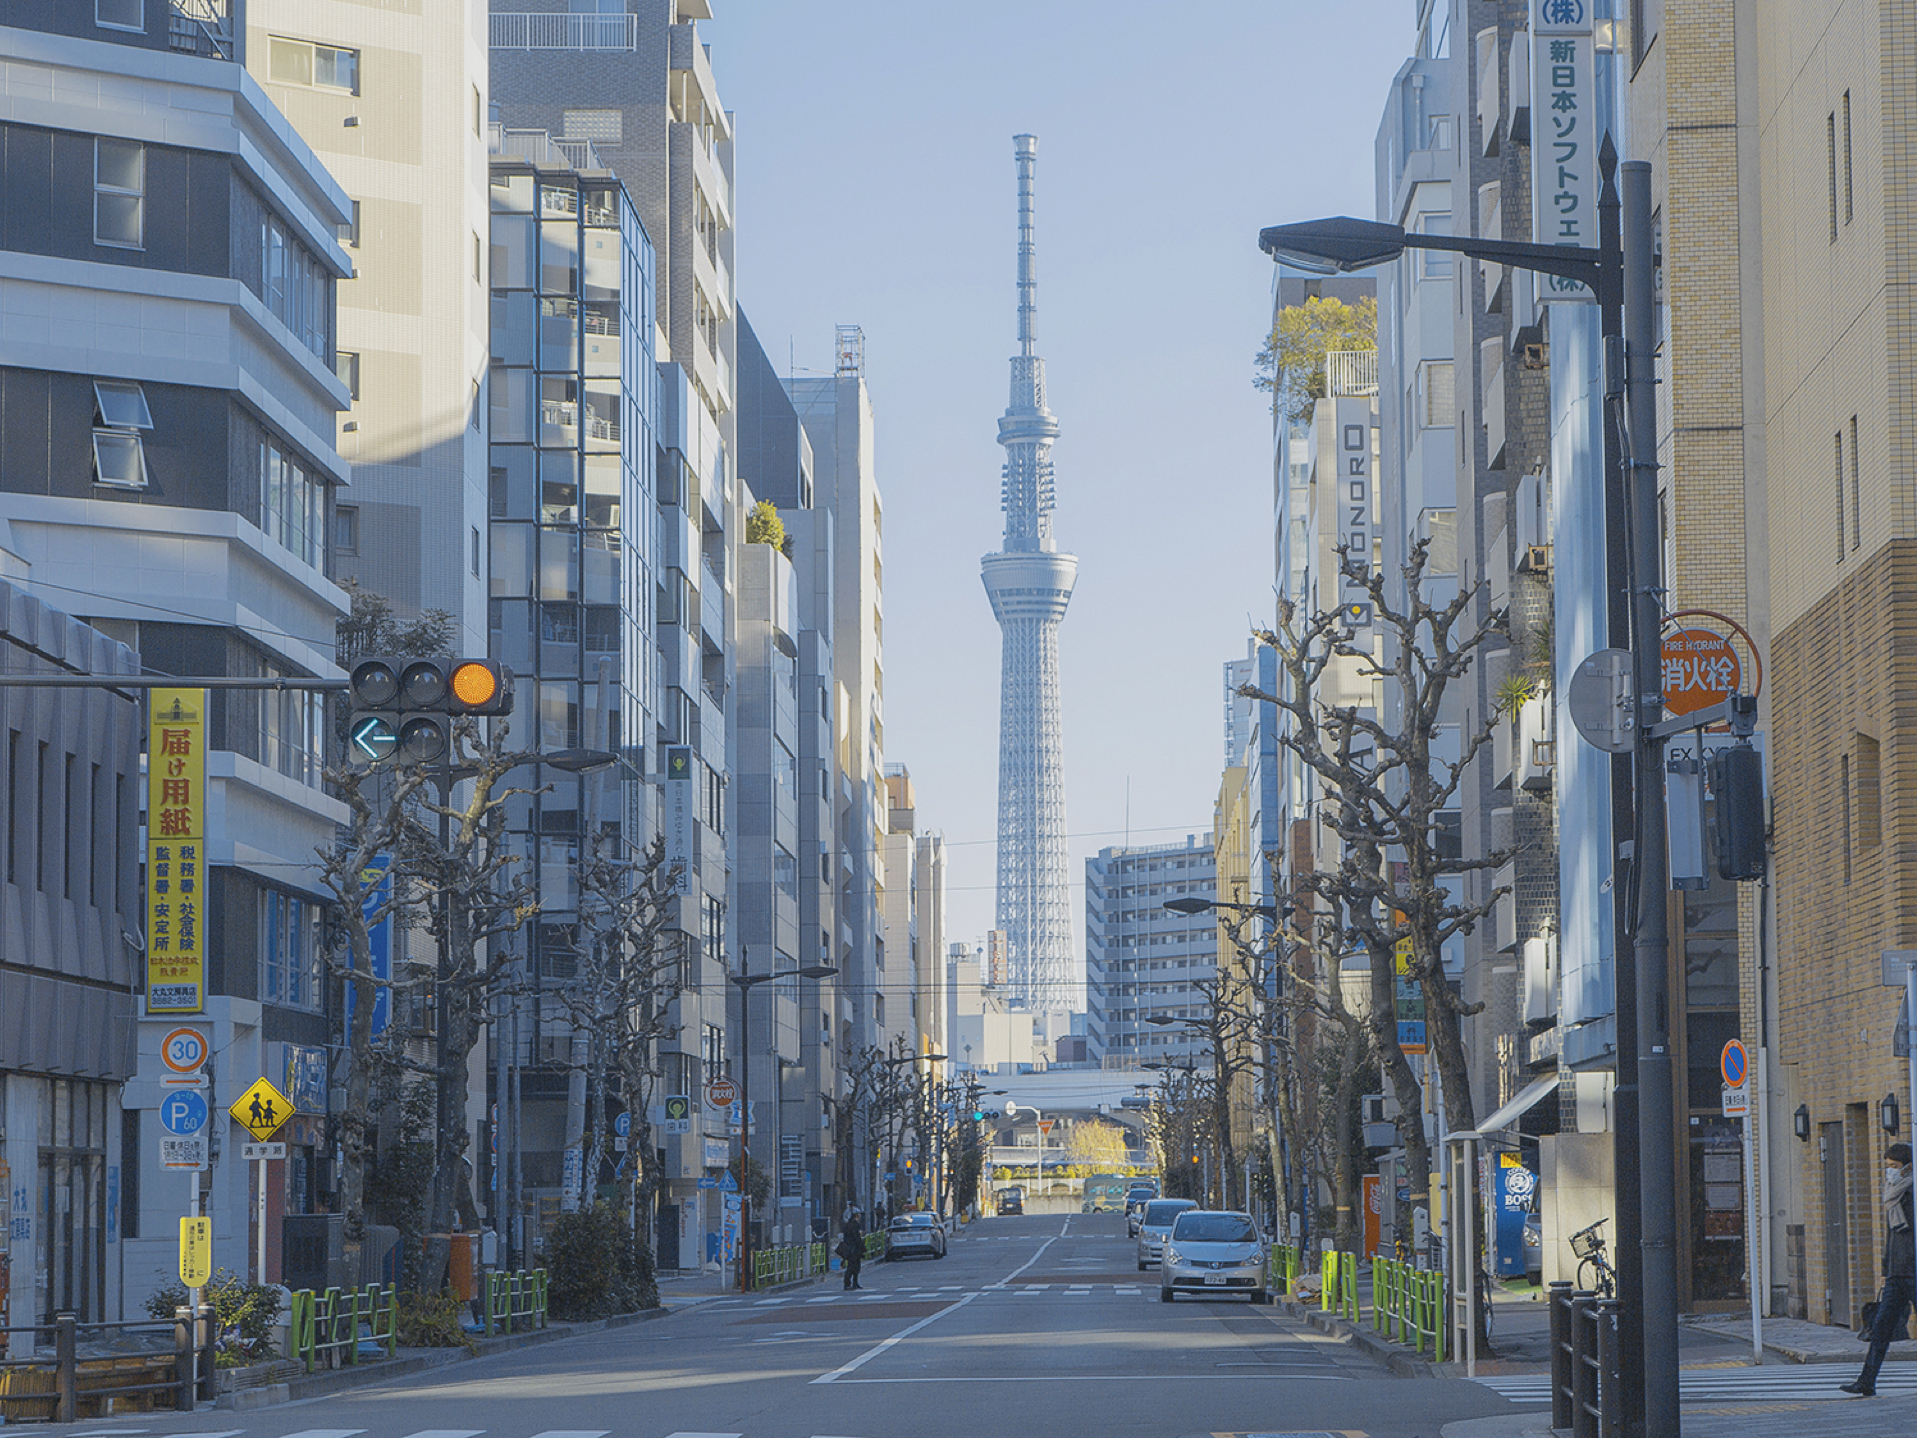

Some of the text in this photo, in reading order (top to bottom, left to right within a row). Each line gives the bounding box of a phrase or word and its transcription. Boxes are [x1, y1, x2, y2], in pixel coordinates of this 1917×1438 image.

[1664, 640, 1726, 652] FIRE HYDRANT
[1661, 656, 1735, 693] 消火栓
[160, 728, 192, 836] 届け用紙
[153, 845, 171, 951] 監督署・安定所
[178, 845, 197, 951] 税務署・社会保険
[152, 986, 196, 997] 大丸文房具店
[172, 1040, 199, 1061] 30
[171, 1102, 190, 1130] P
[620, 1117, 630, 1133] P
[244, 1146, 283, 1156] 通学路
